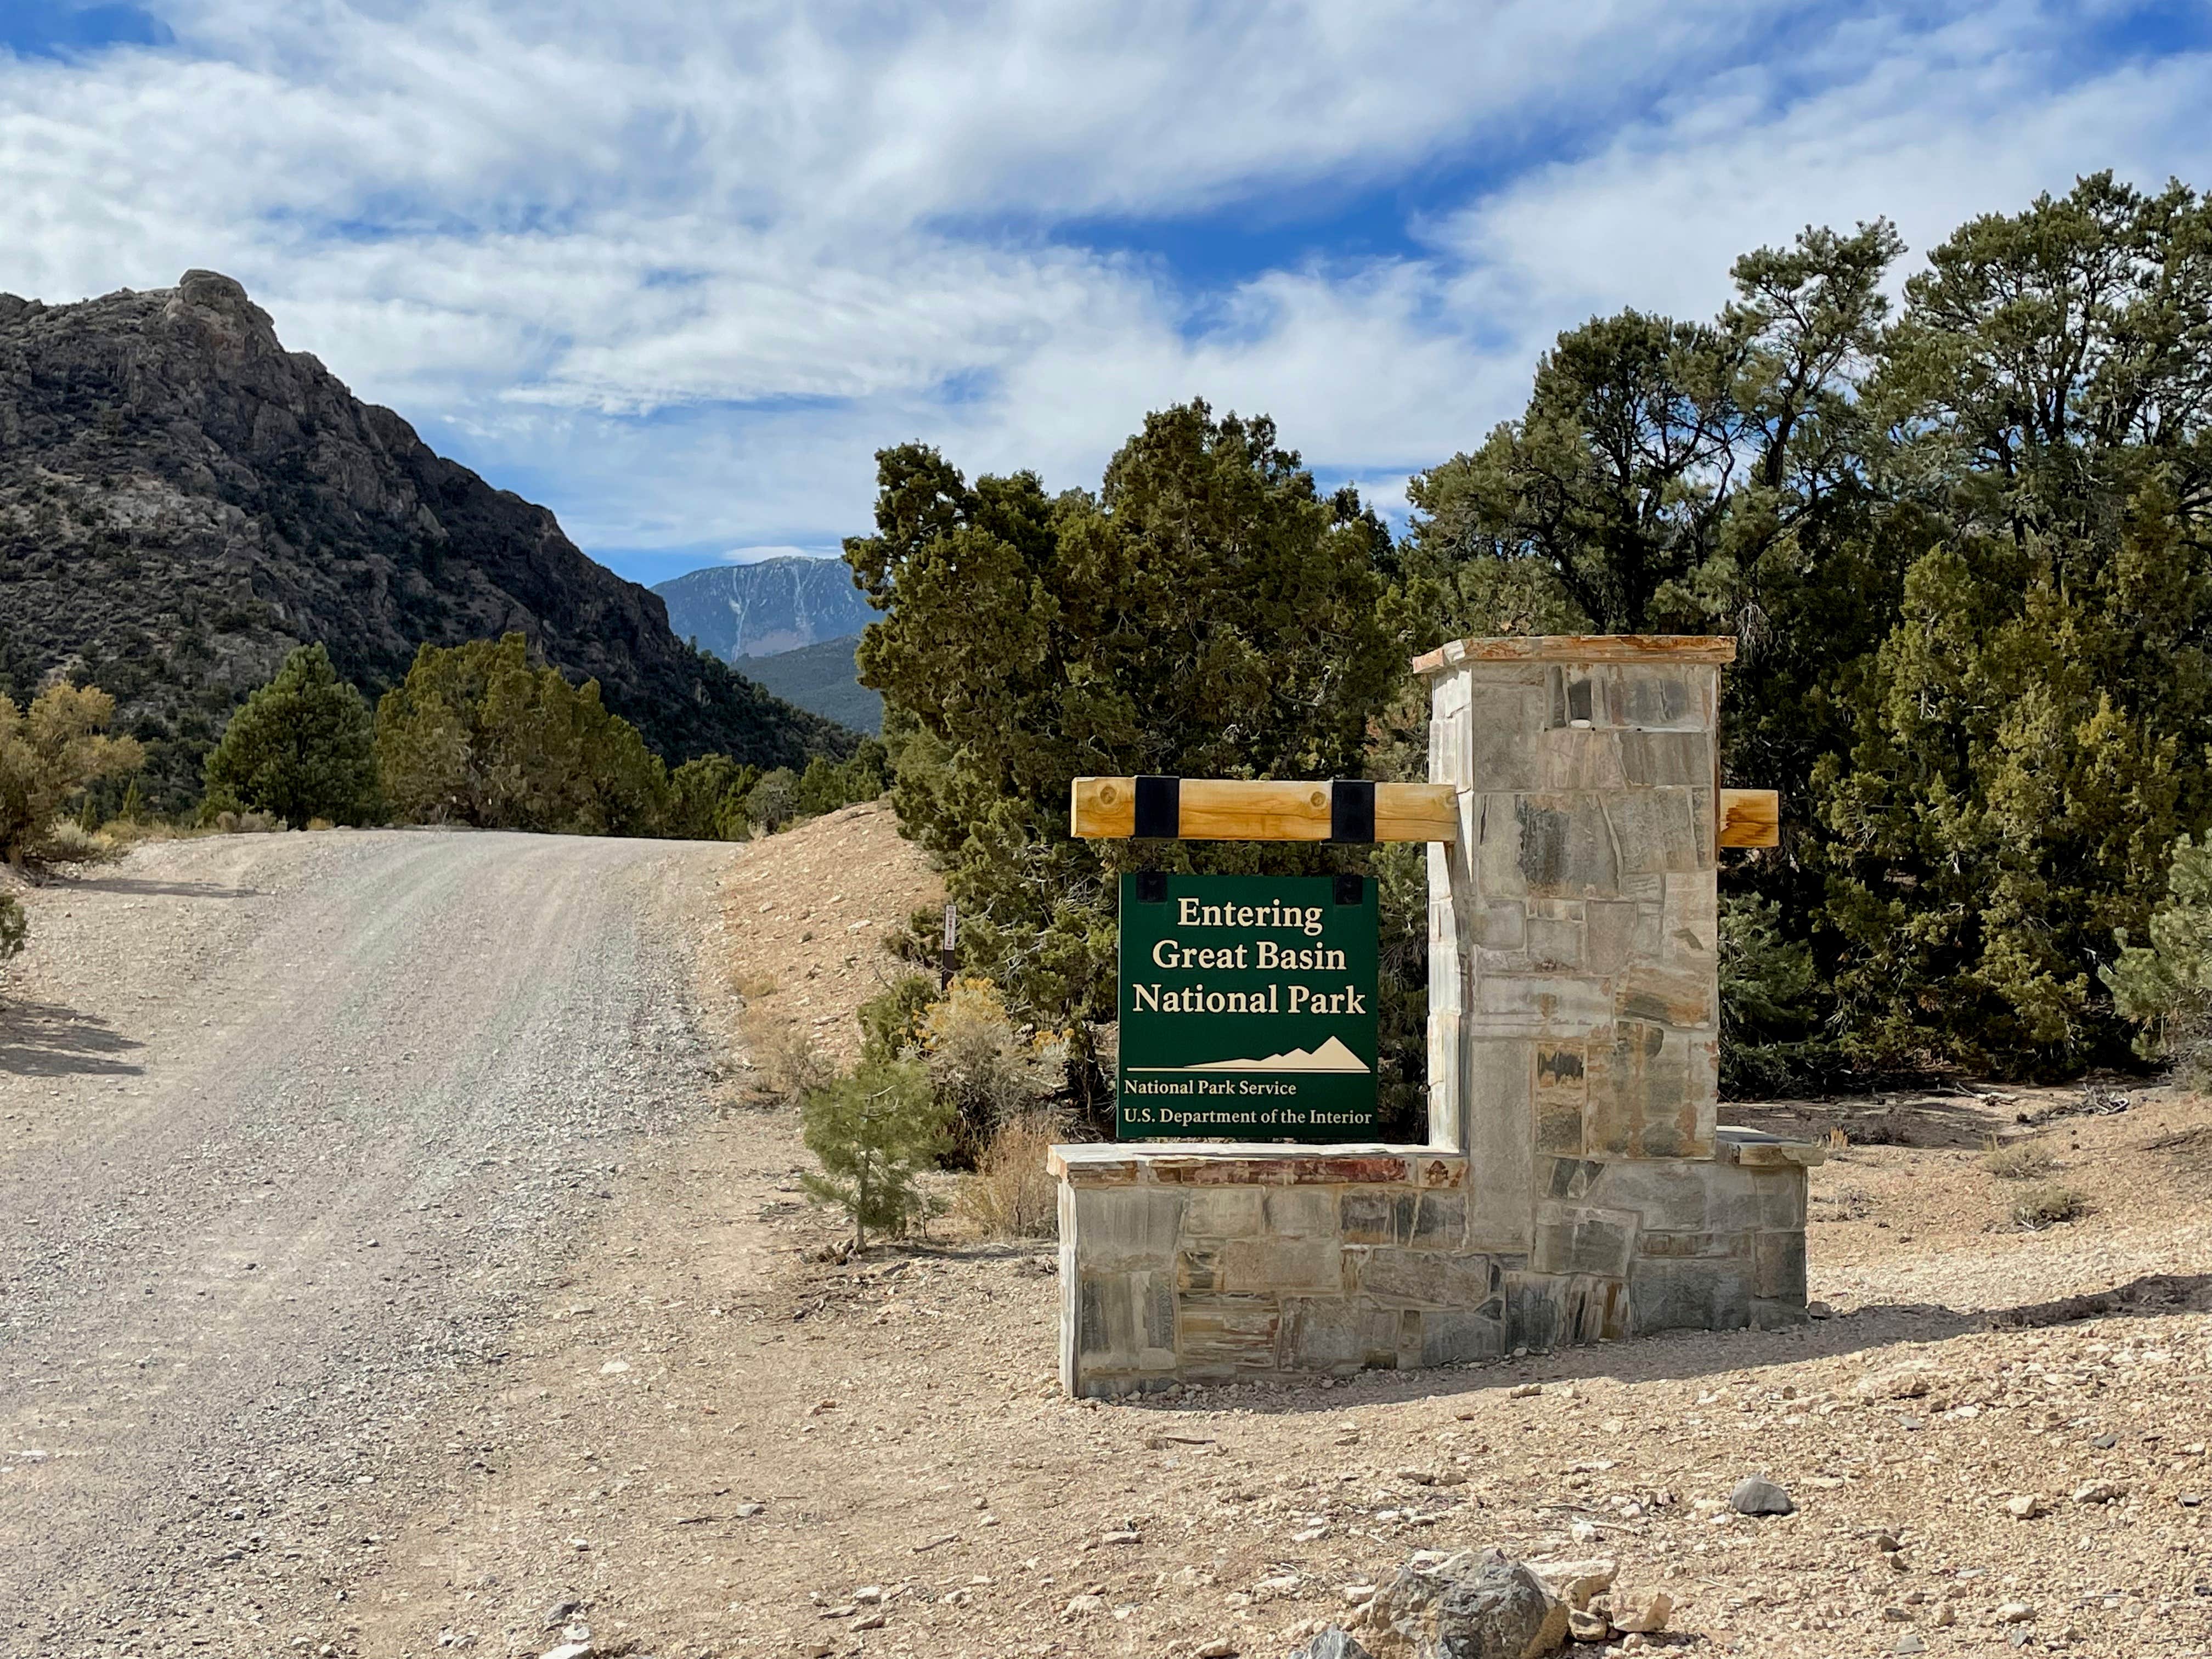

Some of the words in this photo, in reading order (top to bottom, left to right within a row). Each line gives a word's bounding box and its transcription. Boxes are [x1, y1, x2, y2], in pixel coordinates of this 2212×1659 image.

[1177, 898, 1323, 936] Entering
[1153, 939, 1248, 969] Great
[1256, 941, 1347, 970] Basin
[1132, 984, 1279, 1013] National
[1288, 985, 1366, 1014] Park
[1124, 1079, 1194, 1094] National
[1198, 1080, 1235, 1094] Park
[1239, 1080, 1296, 1095] Service
[1124, 1108, 1155, 1122] U.S.
[1160, 1108, 1257, 1127] Department
[1261, 1109, 1278, 1123] of
[1280, 1109, 1306, 1123] the
[1310, 1110, 1372, 1124] Interior
